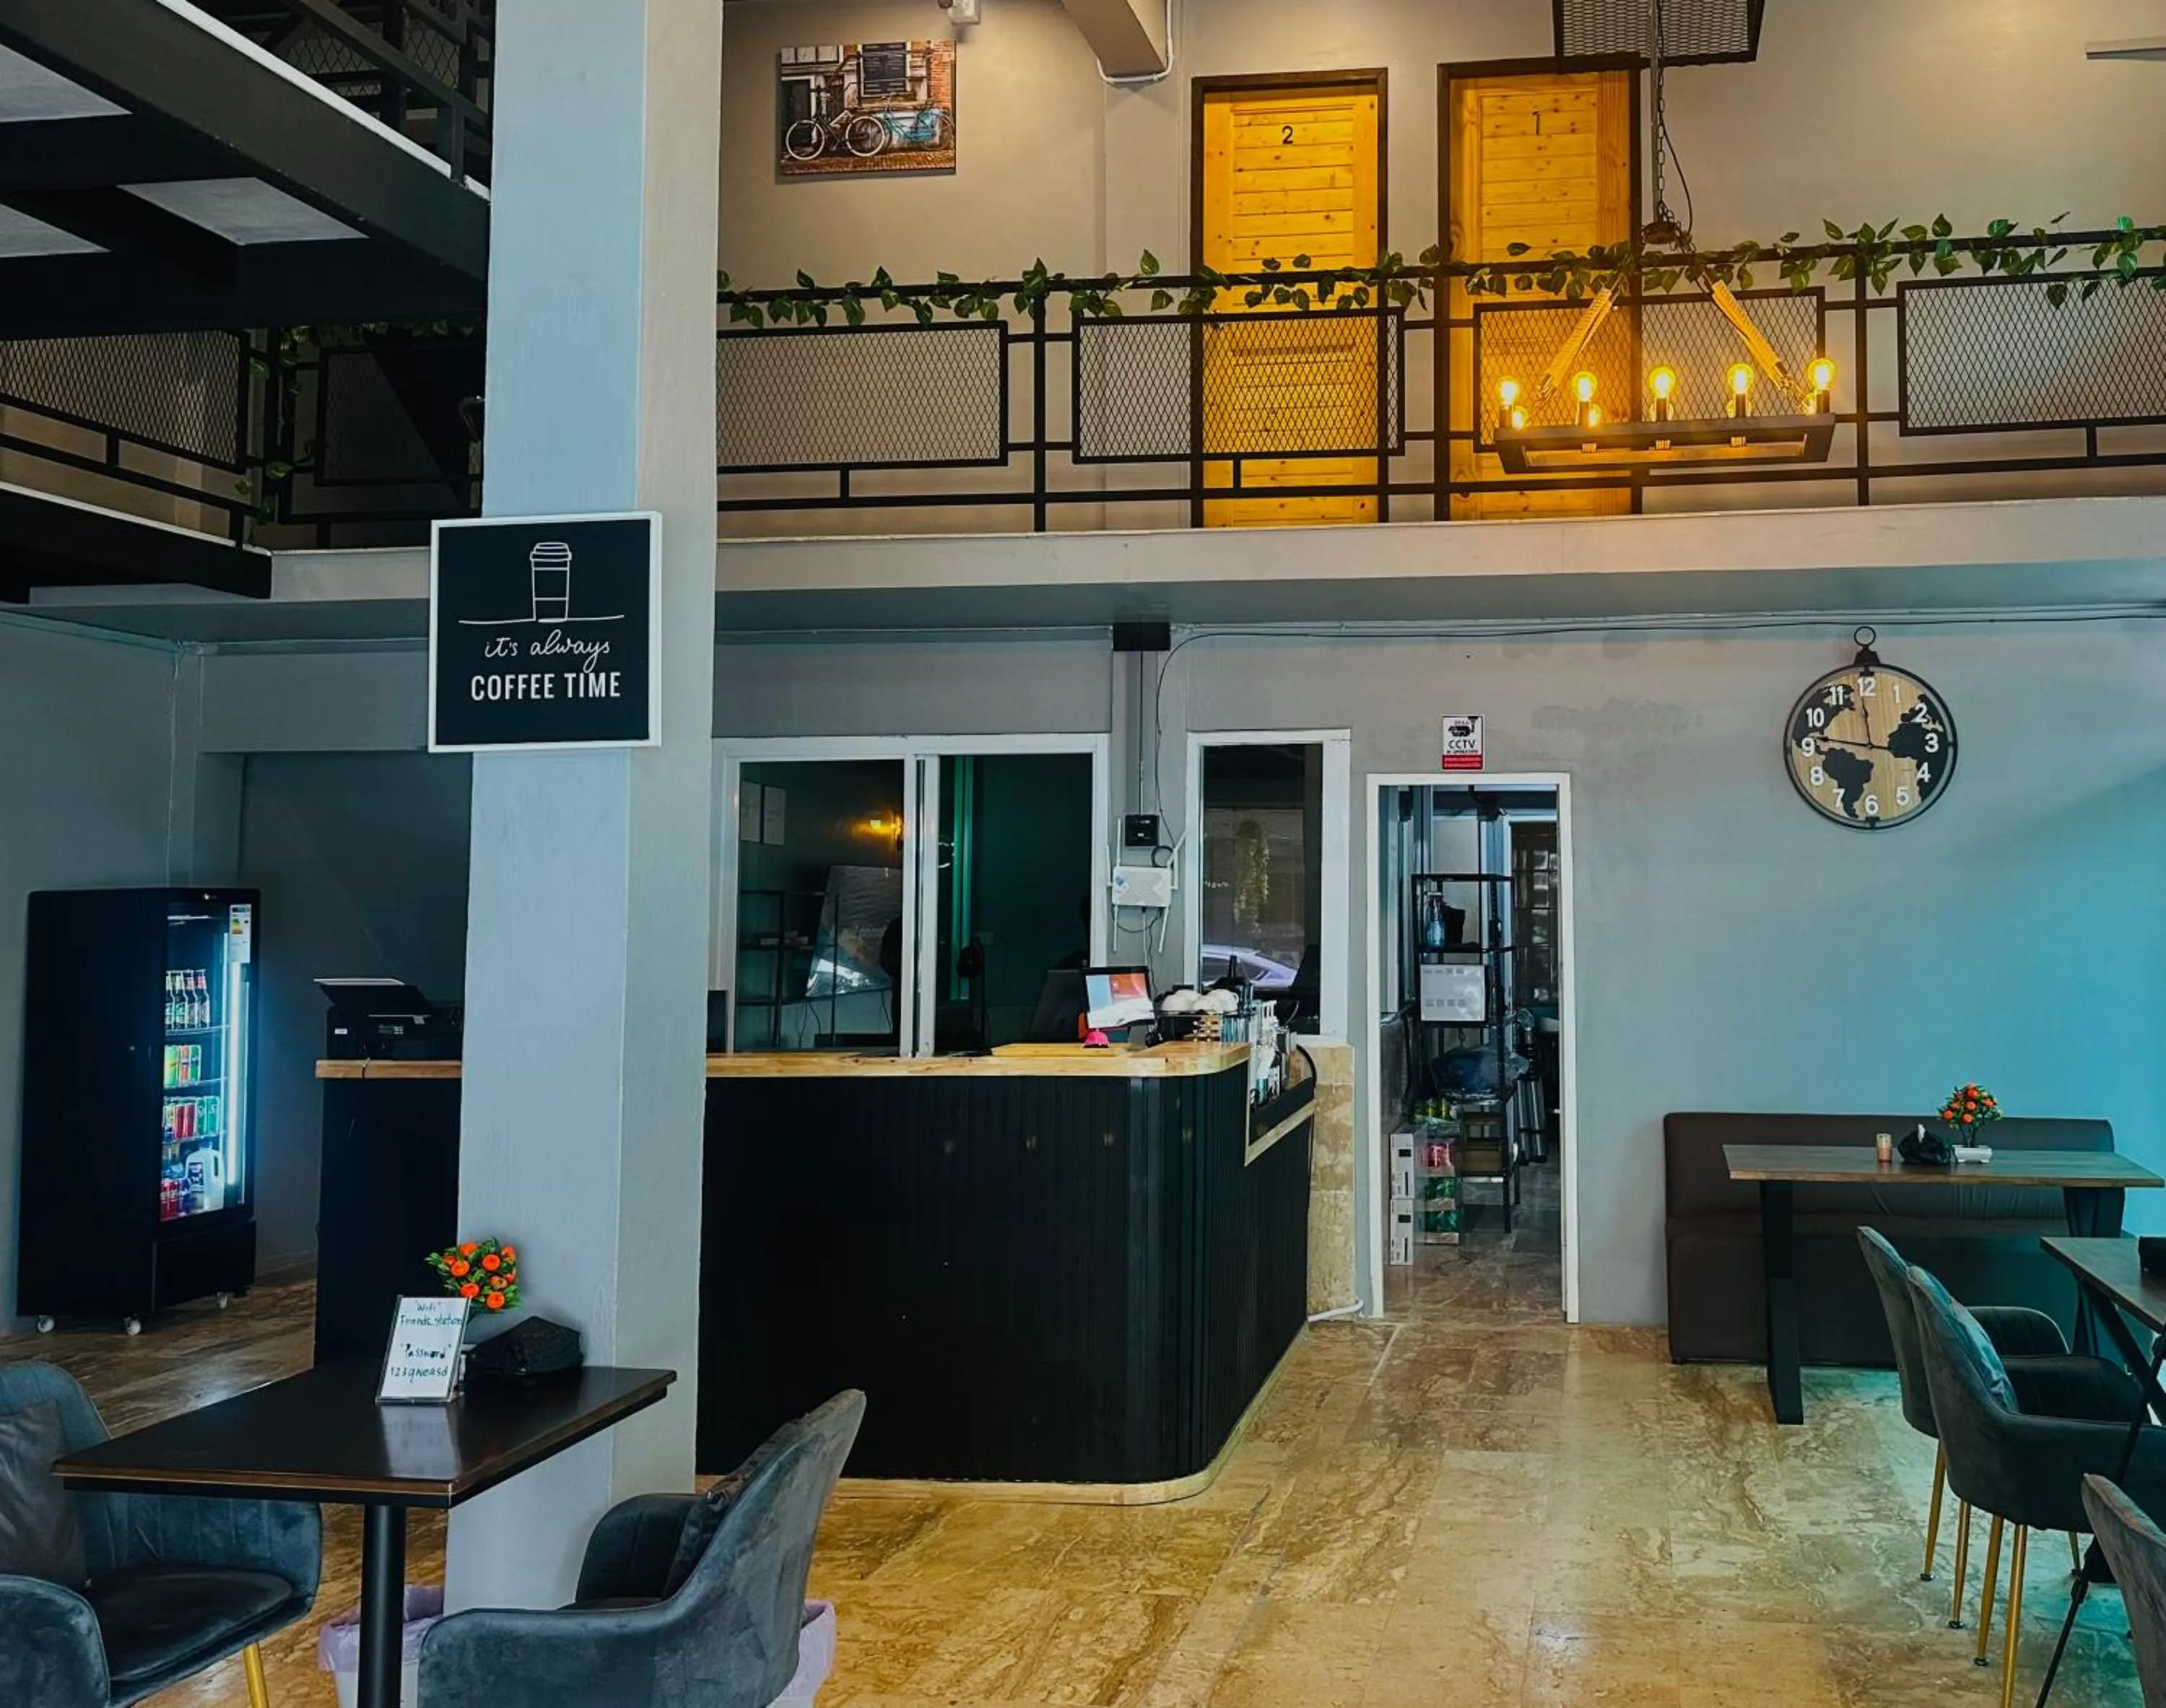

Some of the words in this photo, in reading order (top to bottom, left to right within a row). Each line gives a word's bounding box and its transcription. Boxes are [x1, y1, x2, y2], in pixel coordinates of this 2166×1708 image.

[1532, 110, 1541, 136] 1
[1282, 125, 1294, 145] 2
[484, 637, 518, 658] it's
[530, 629, 611, 674] always
[471, 673, 555, 701] COFFEE
[564, 671, 622, 698] TIME
[1829, 686, 1843, 705] 11
[1857, 677, 1876, 697] 12
[1892, 685, 1901, 703] 1
[1806, 707, 1824, 728] 10
[1915, 703, 1928, 723] 2
[1448, 739, 1476, 749] CCTV
[1801, 738, 1815, 757] 9
[1924, 733, 1939, 753] 3
[1810, 767, 1824, 785] 8
[1916, 762, 1931, 783] 4
[1832, 788, 1845, 808] 7
[1865, 796, 1879, 814] 6
[1896, 787, 1910, 806] 5
